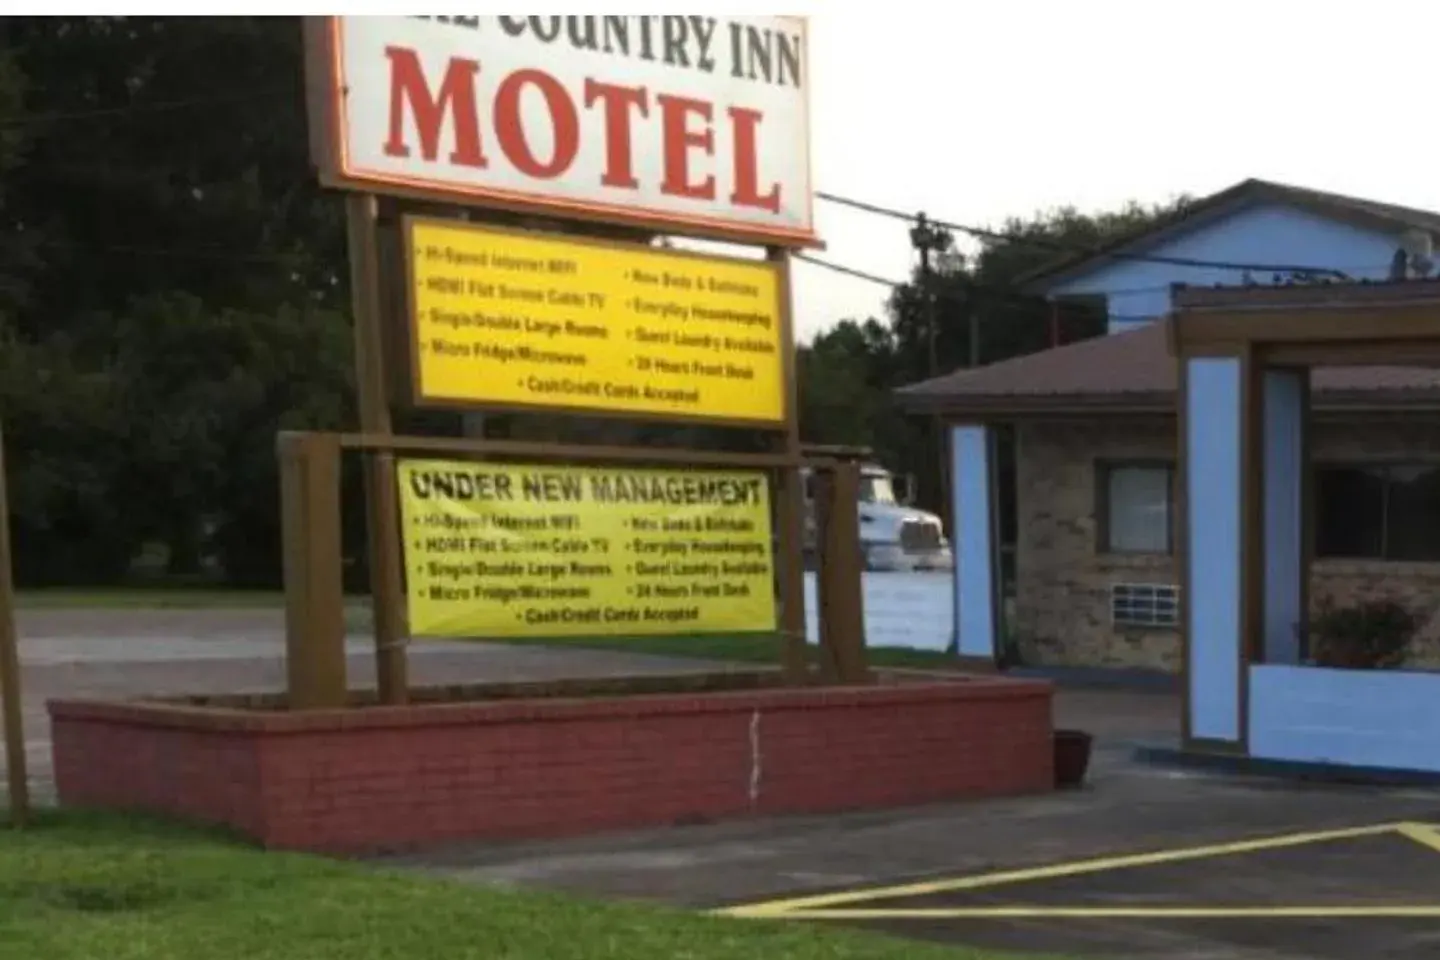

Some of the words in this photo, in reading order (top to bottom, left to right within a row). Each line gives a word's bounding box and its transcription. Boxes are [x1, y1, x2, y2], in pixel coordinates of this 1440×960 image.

[729, 22, 803, 89] INN
[383, 45, 783, 215] MOTEL
[588, 291, 607, 311] TV
[525, 316, 562, 339] Large
[431, 337, 470, 357] Micro
[604, 381, 641, 400] Cards
[410, 469, 514, 501] UNDER
[521, 471, 585, 503] NEW
[588, 473, 763, 506] MANAGEMENT
[590, 536, 610, 554] TV
[528, 562, 567, 580] Large
[429, 585, 471, 601] Micro
[604, 608, 641, 624] Cards
[644, 605, 700, 623] Accepted
